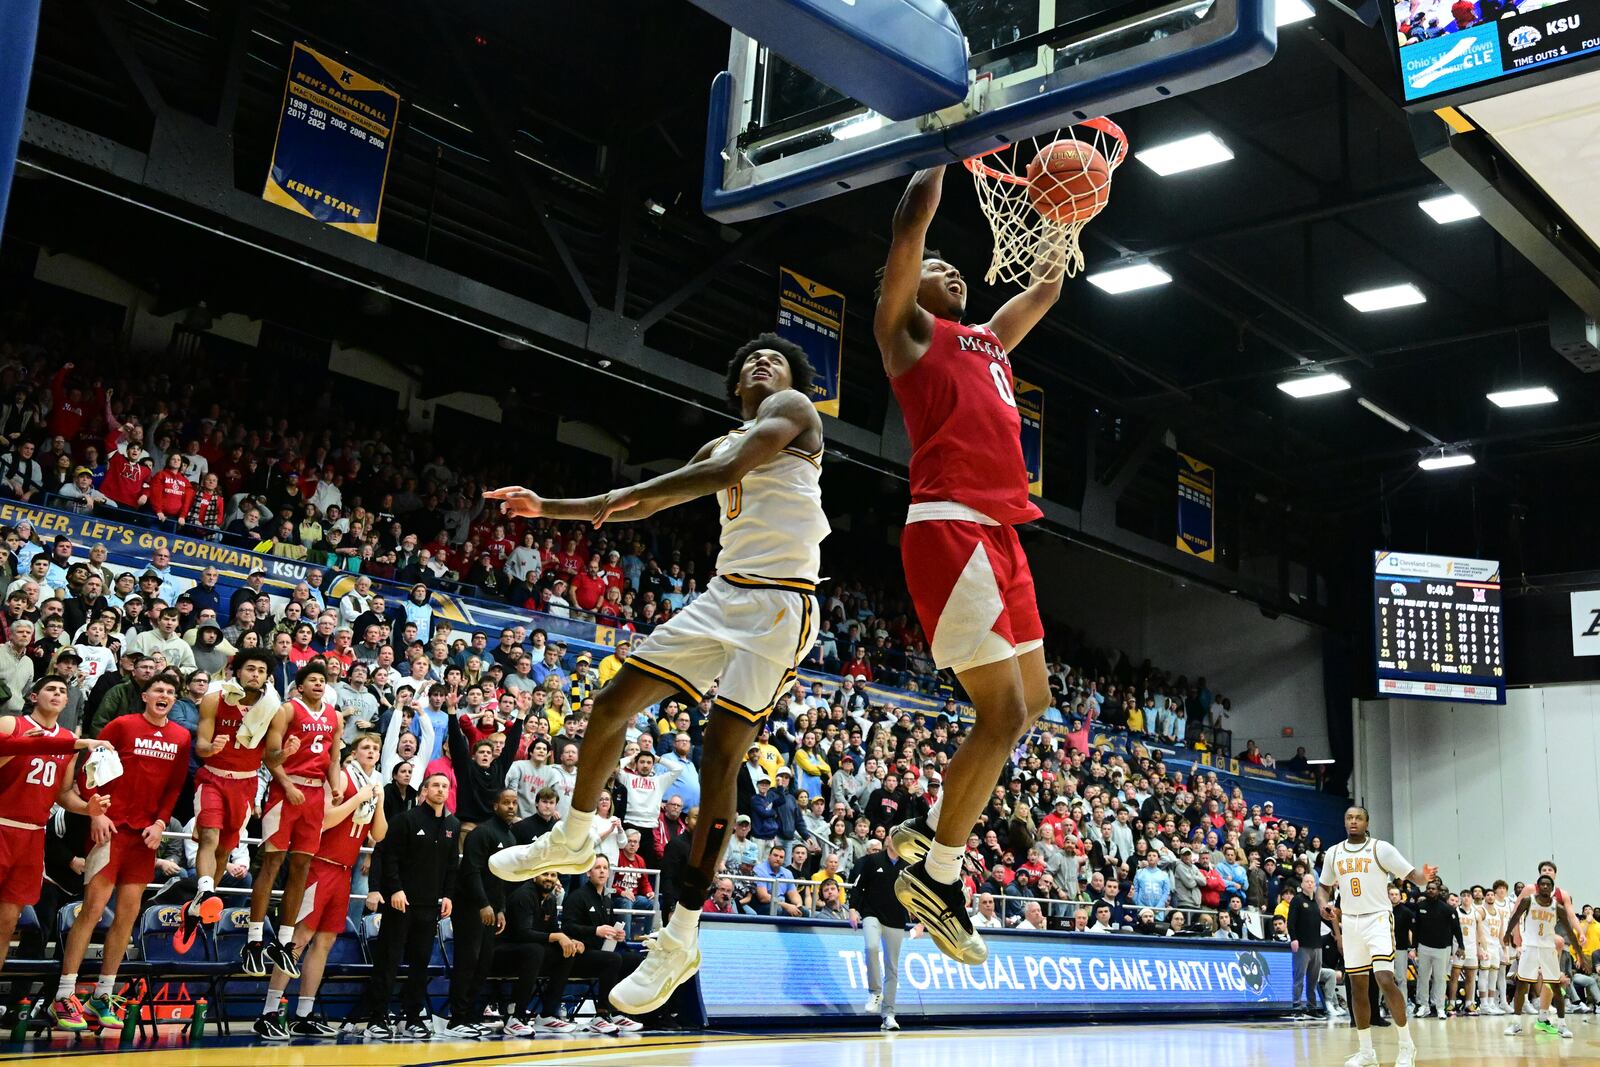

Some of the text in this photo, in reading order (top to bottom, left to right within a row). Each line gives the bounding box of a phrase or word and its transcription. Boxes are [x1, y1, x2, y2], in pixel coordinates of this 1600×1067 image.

[1546, 14, 1581, 36] KSU
[1464, 49, 1494, 69] CLE
[1513, 45, 1569, 68] TIME OUTS 1
[296, 71, 388, 122] MEN'S BASKETBALL
[288, 107, 326, 130] 2017 2023
[290, 97, 308, 112] 1999
[309, 107, 327, 121] 2001
[330, 116, 348, 131] 2002
[350, 126, 367, 140] 2006
[287, 179, 361, 218] KENT STATE
[989, 361, 1017, 408] 0
[1, 504, 75, 536] ETHER,
[80, 521, 135, 545] LET'S
[138, 533, 168, 552] GO
[1382, 628, 1388, 637] 2
[88, 661, 97, 676] 3
[1458, 664, 1472, 674] 102
[302, 723, 334, 734] MIAMI
[134, 737, 178, 753] MIAMI
[310, 735, 324, 754] 6
[26, 757, 57, 788] 20
[1336, 857, 1371, 876] KENT
[1350, 877, 1362, 897] 8
[904, 951, 1025, 990] OFFICIAL
[1024, 955, 1086, 990] POST
[1088, 956, 1157, 991] GAME
[1155, 959, 1214, 991] PARTY
[171, 1008, 182, 1019] G
